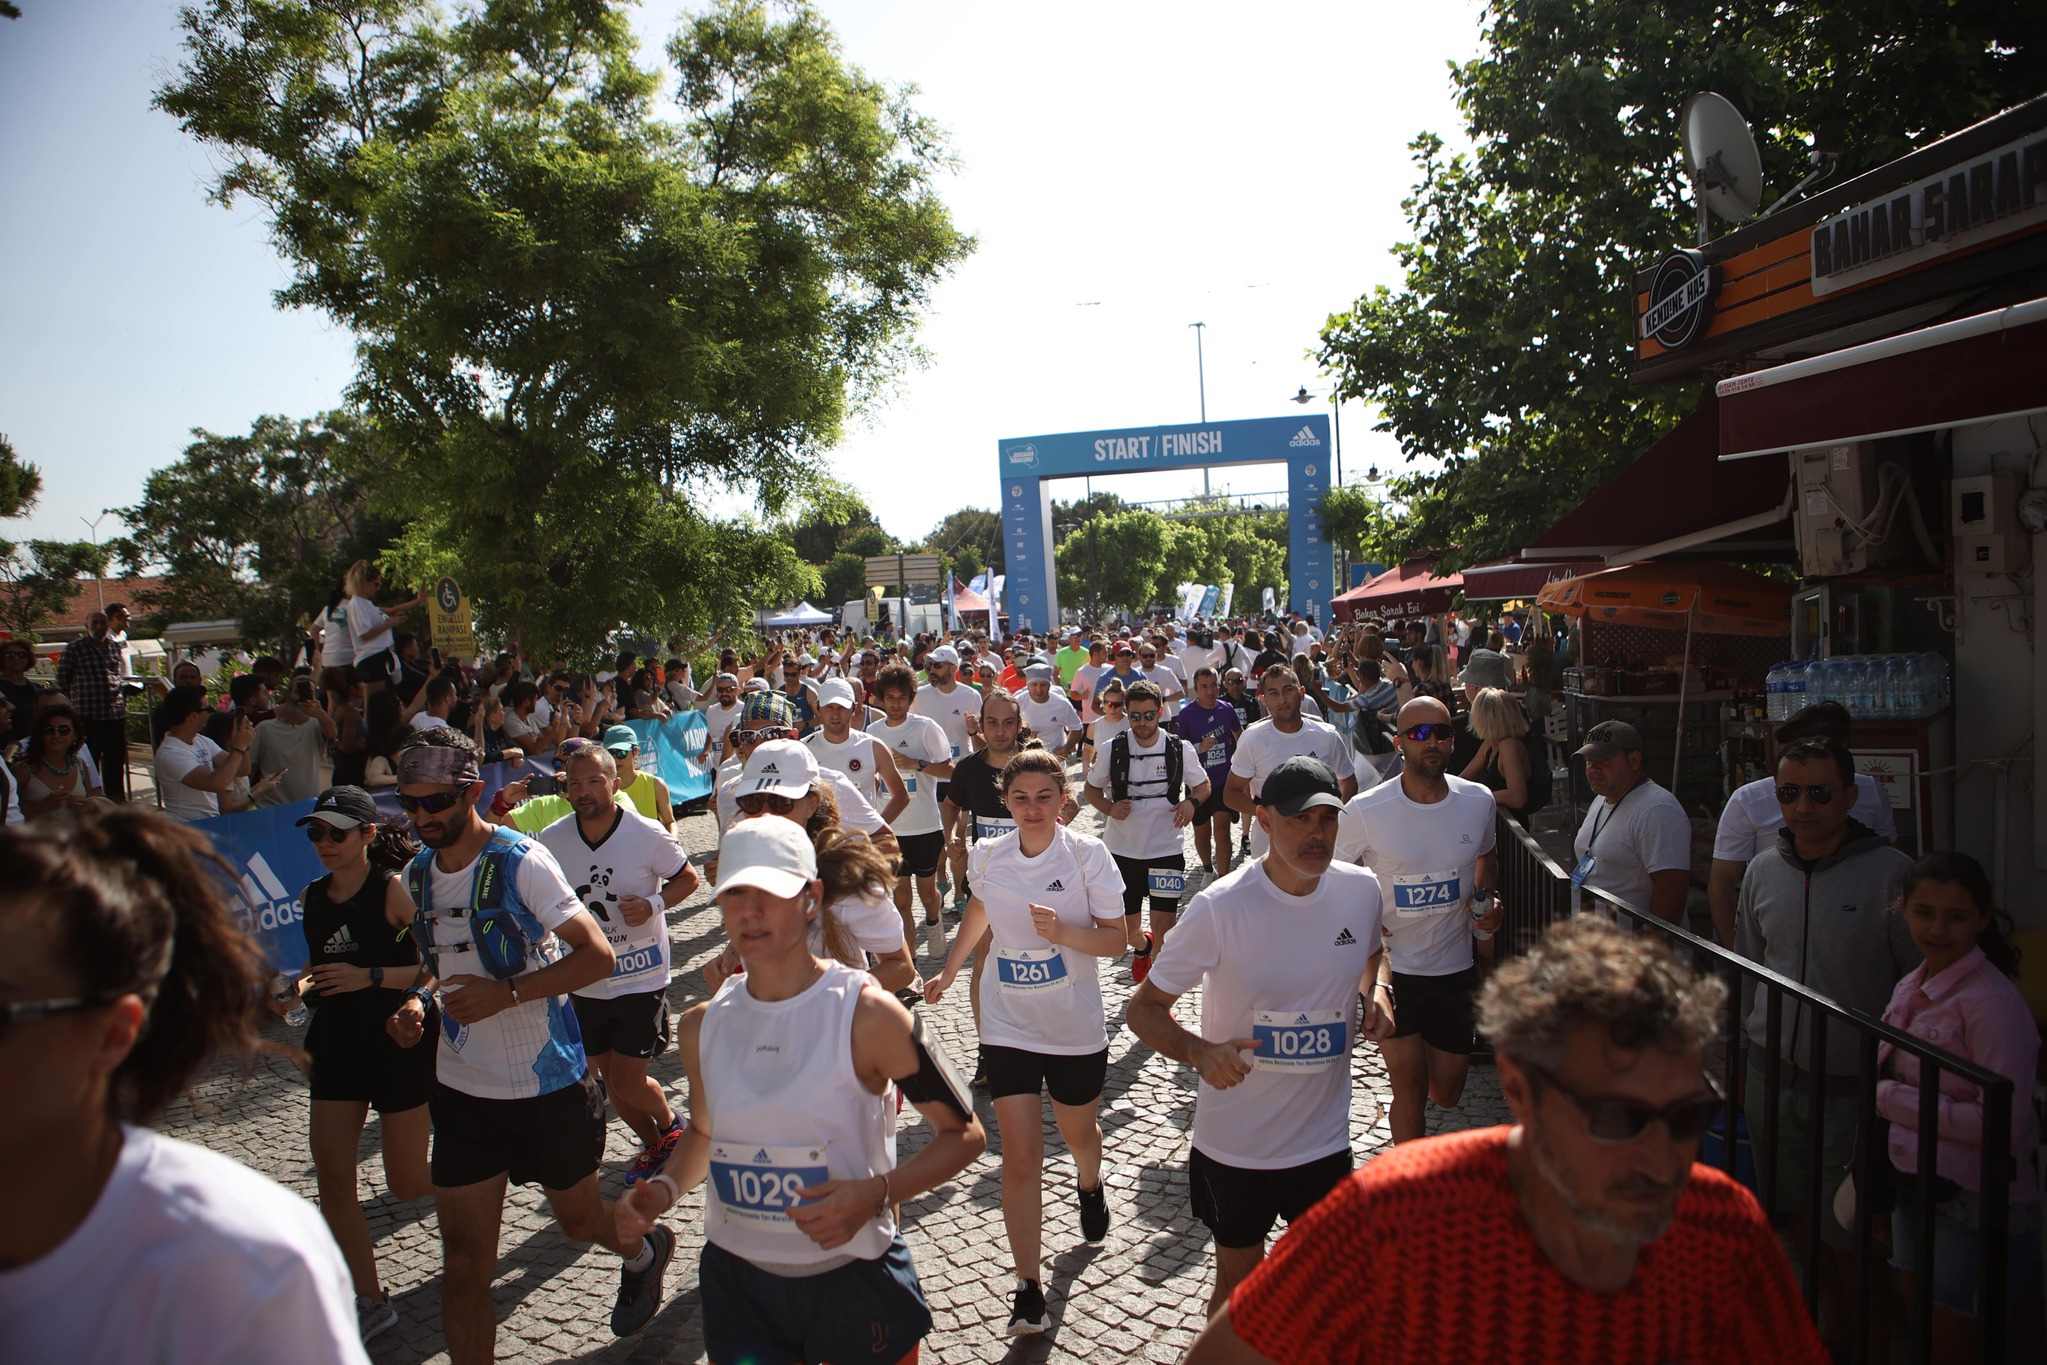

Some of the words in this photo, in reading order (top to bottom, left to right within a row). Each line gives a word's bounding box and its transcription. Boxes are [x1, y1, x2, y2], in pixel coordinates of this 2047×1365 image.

[1814, 194, 1912, 278] BAHAR
[1686, 273, 1705, 304] HAS
[1094, 435, 1150, 461] START
[1162, 430, 1222, 457] FINISH
[1289, 438, 1321, 447] adidas
[438, 625, 466, 634] RAMPASI
[1207, 749, 1226, 760] 1054
[1155, 876, 1181, 889] 1040
[1406, 884, 1450, 905] 1274
[323, 941, 359, 954] adidas
[1334, 938, 1357, 946] adidas
[616, 950, 652, 973] 1001
[1010, 962, 1051, 982] 1261
[1271, 1028, 1332, 1056] 1028
[729, 1169, 804, 1207] 1029
